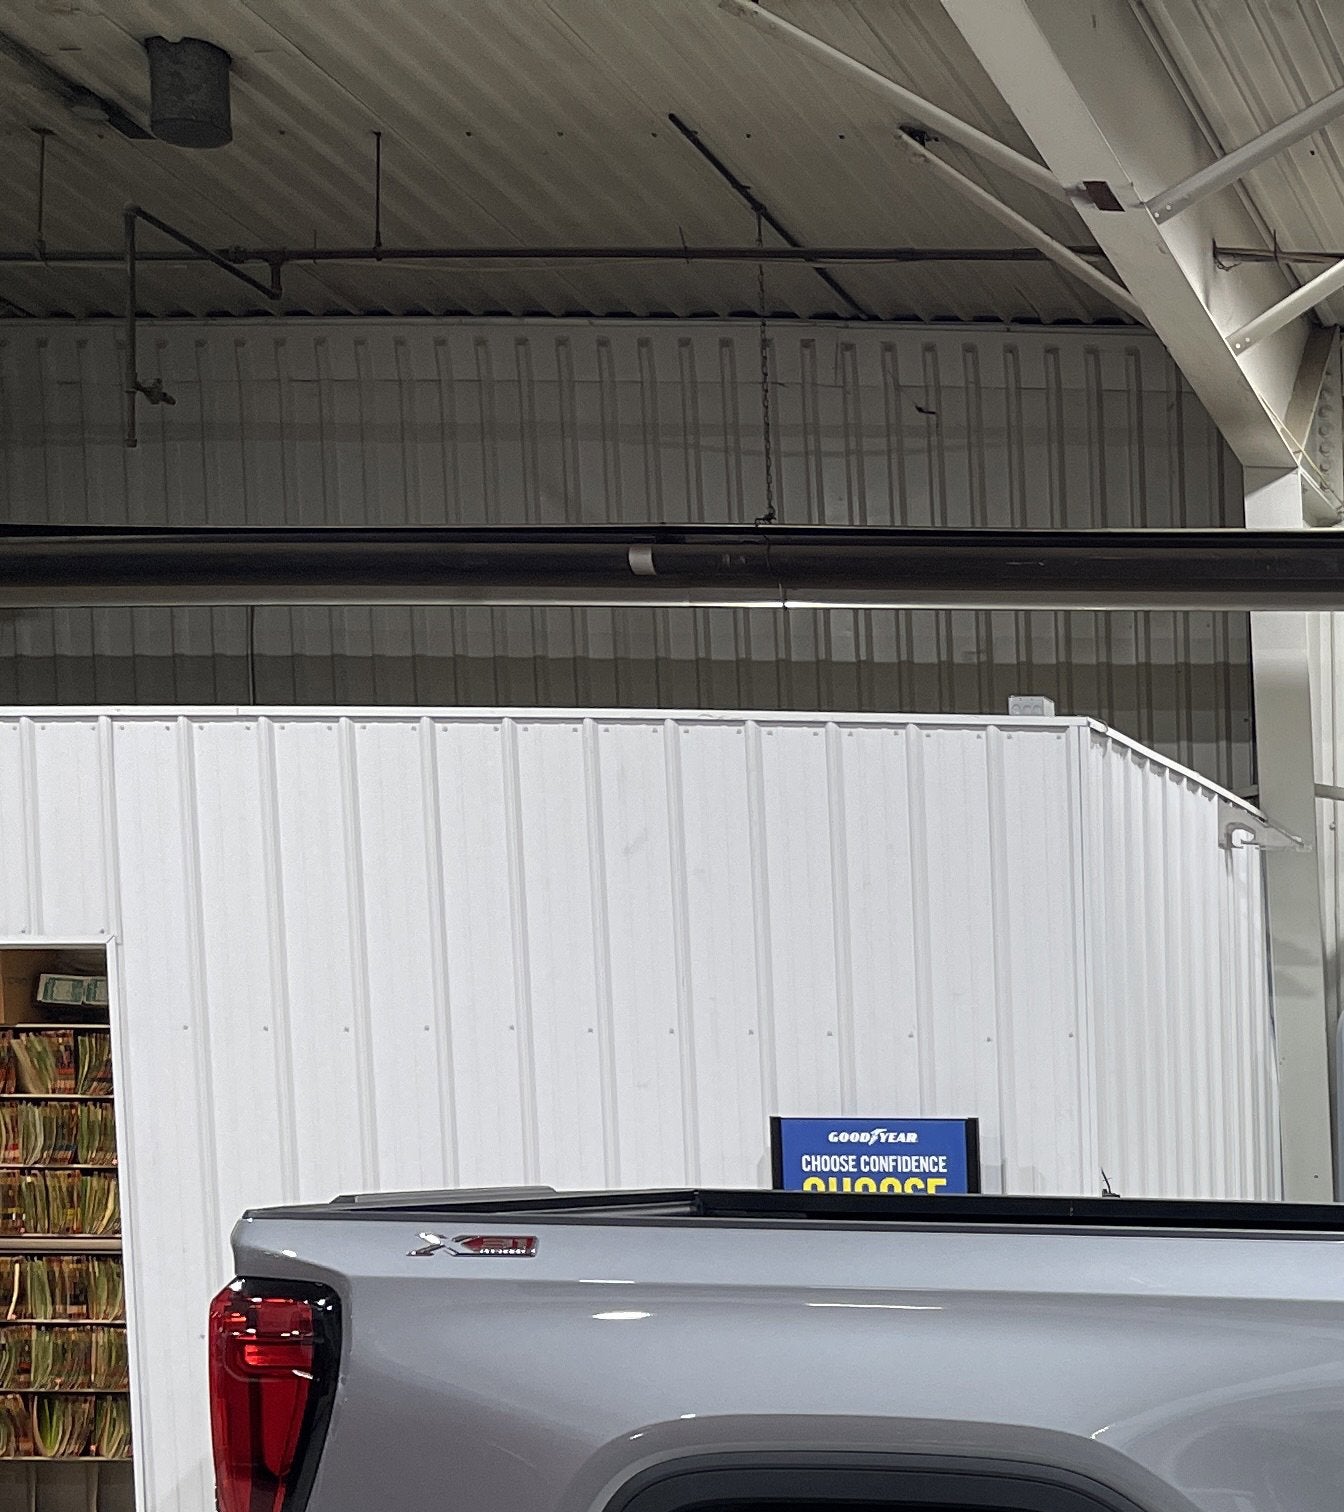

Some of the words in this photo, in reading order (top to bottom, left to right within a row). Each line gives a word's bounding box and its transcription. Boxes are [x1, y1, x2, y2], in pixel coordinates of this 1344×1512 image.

[828, 1128, 918, 1146] GOODYEAR
[801, 1154, 857, 1173] CHOOSE
[860, 1155, 948, 1173] CONFIDENCE
